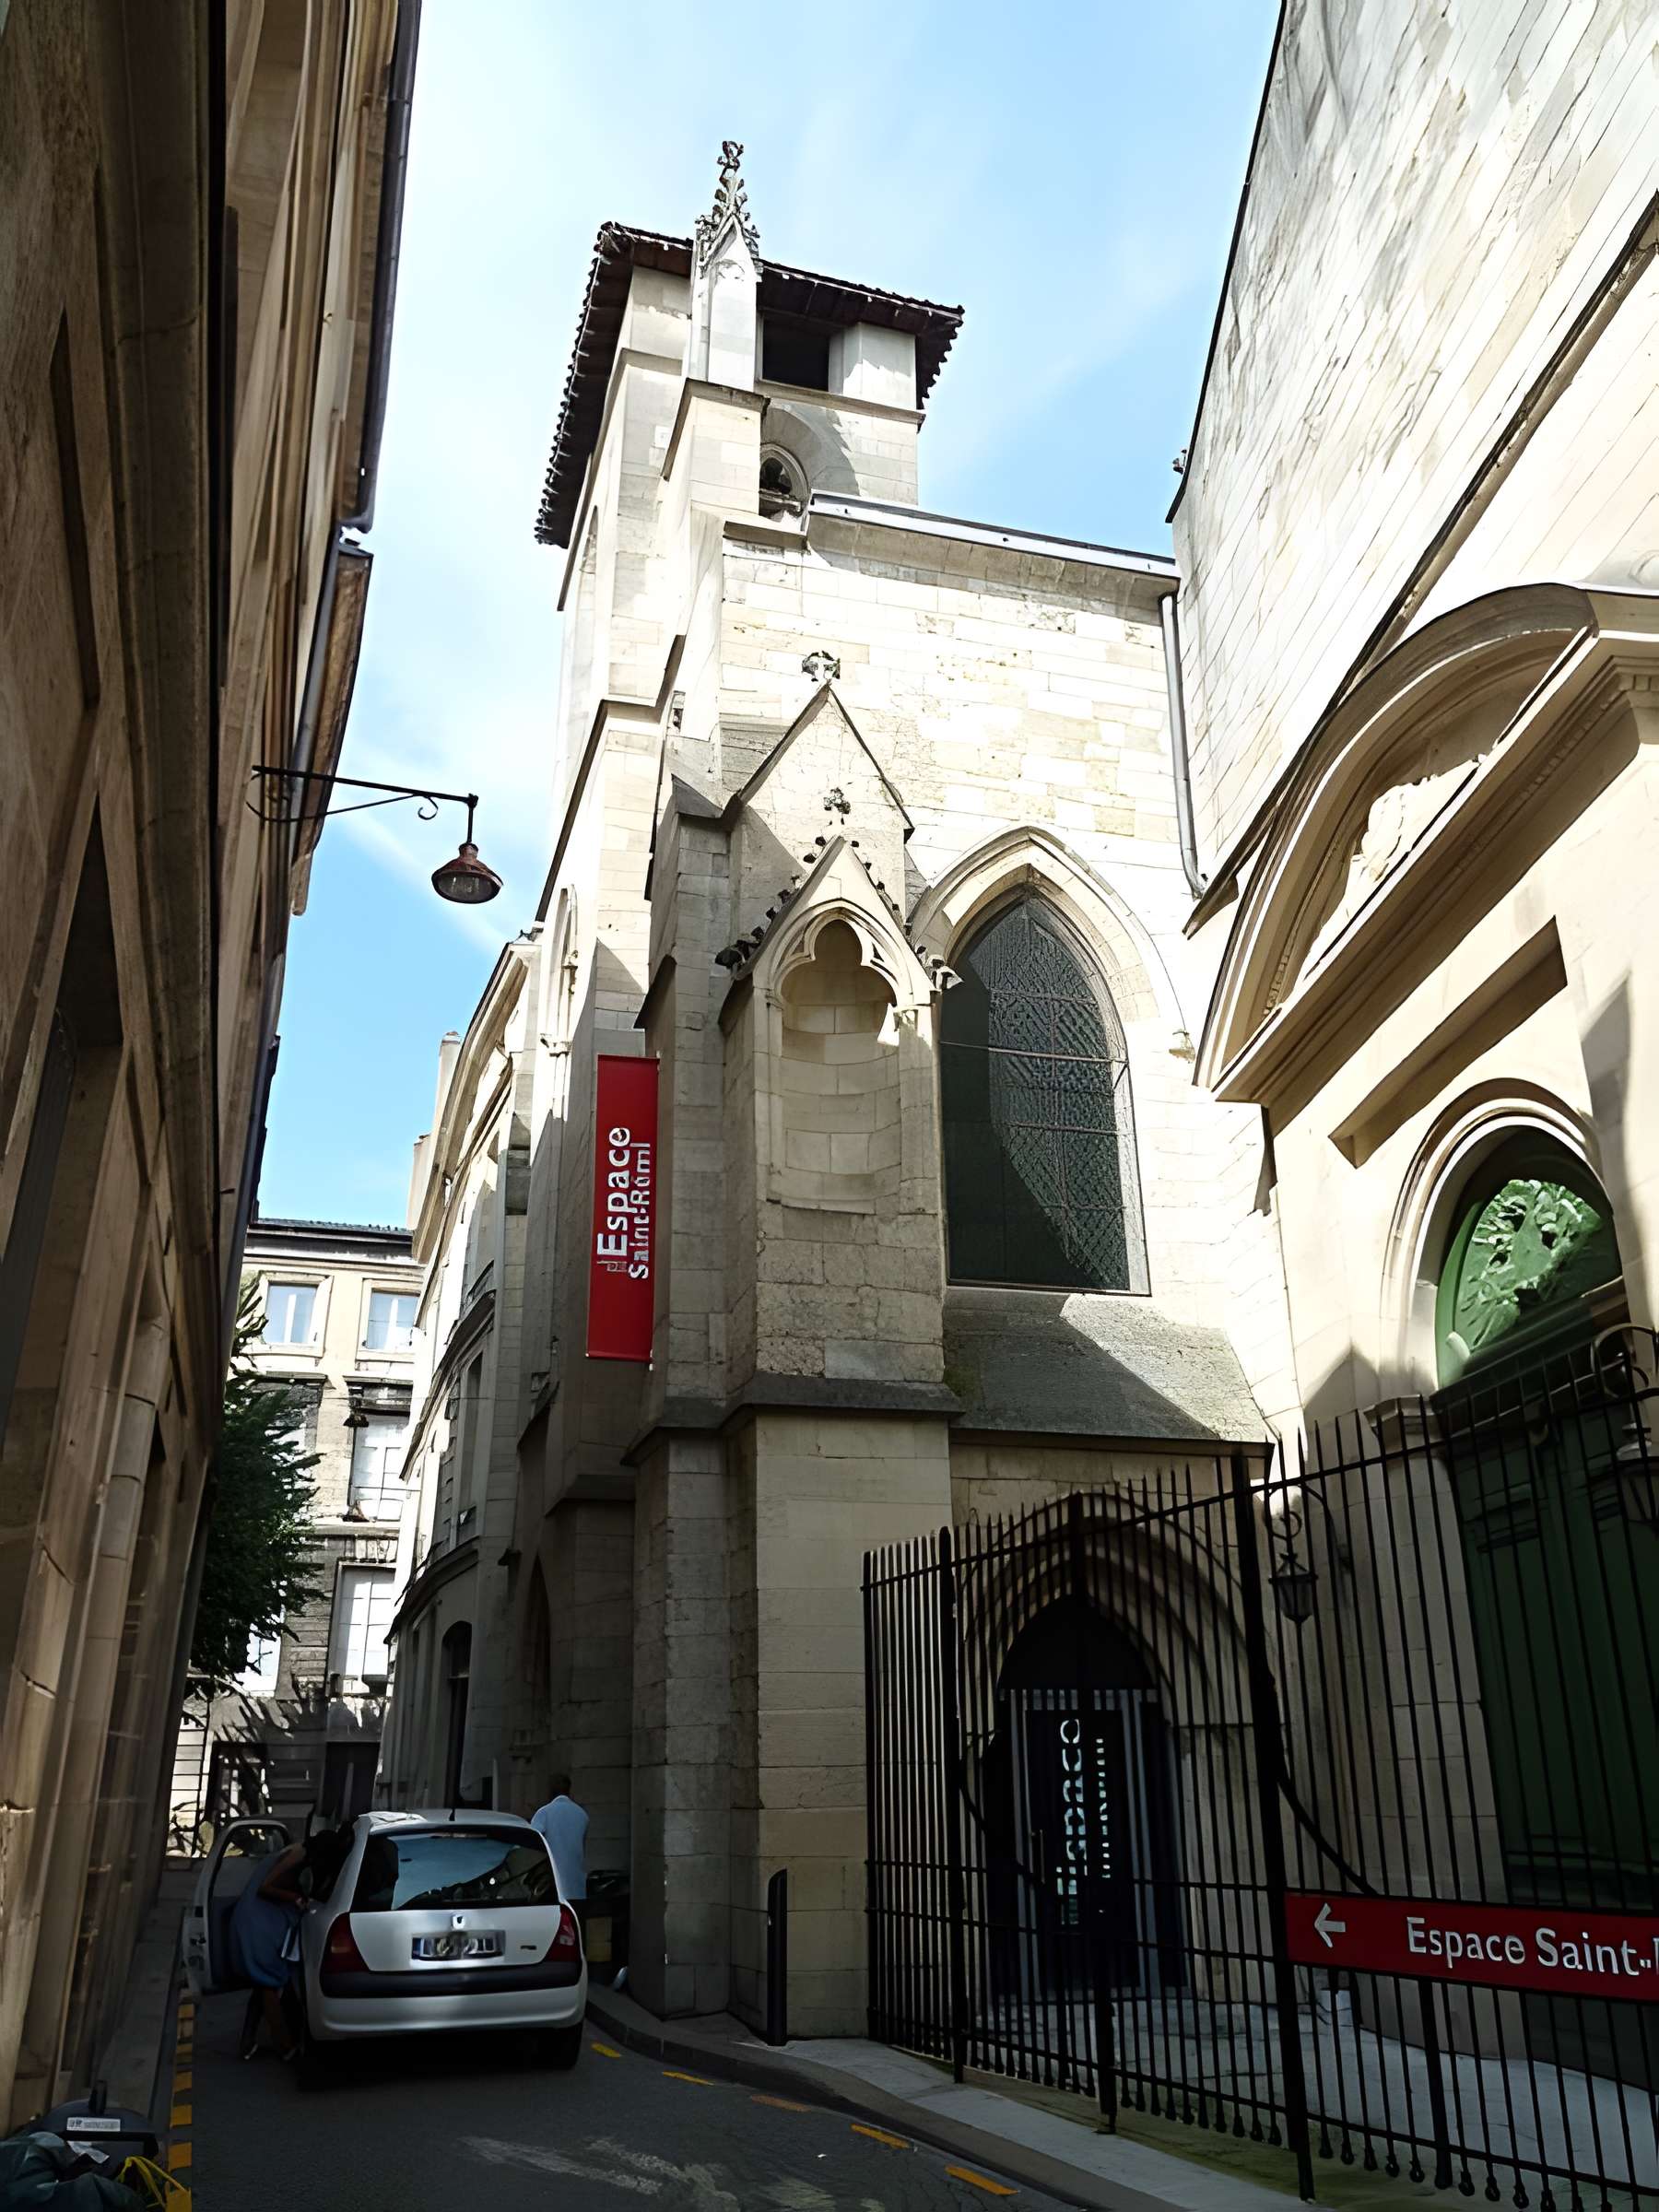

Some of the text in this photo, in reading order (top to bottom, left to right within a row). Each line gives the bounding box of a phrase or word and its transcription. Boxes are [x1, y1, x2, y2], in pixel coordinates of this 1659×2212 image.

[596, 1127, 638, 1256] Espace
[1406, 1916, 1659, 1977] Espace Saint-
